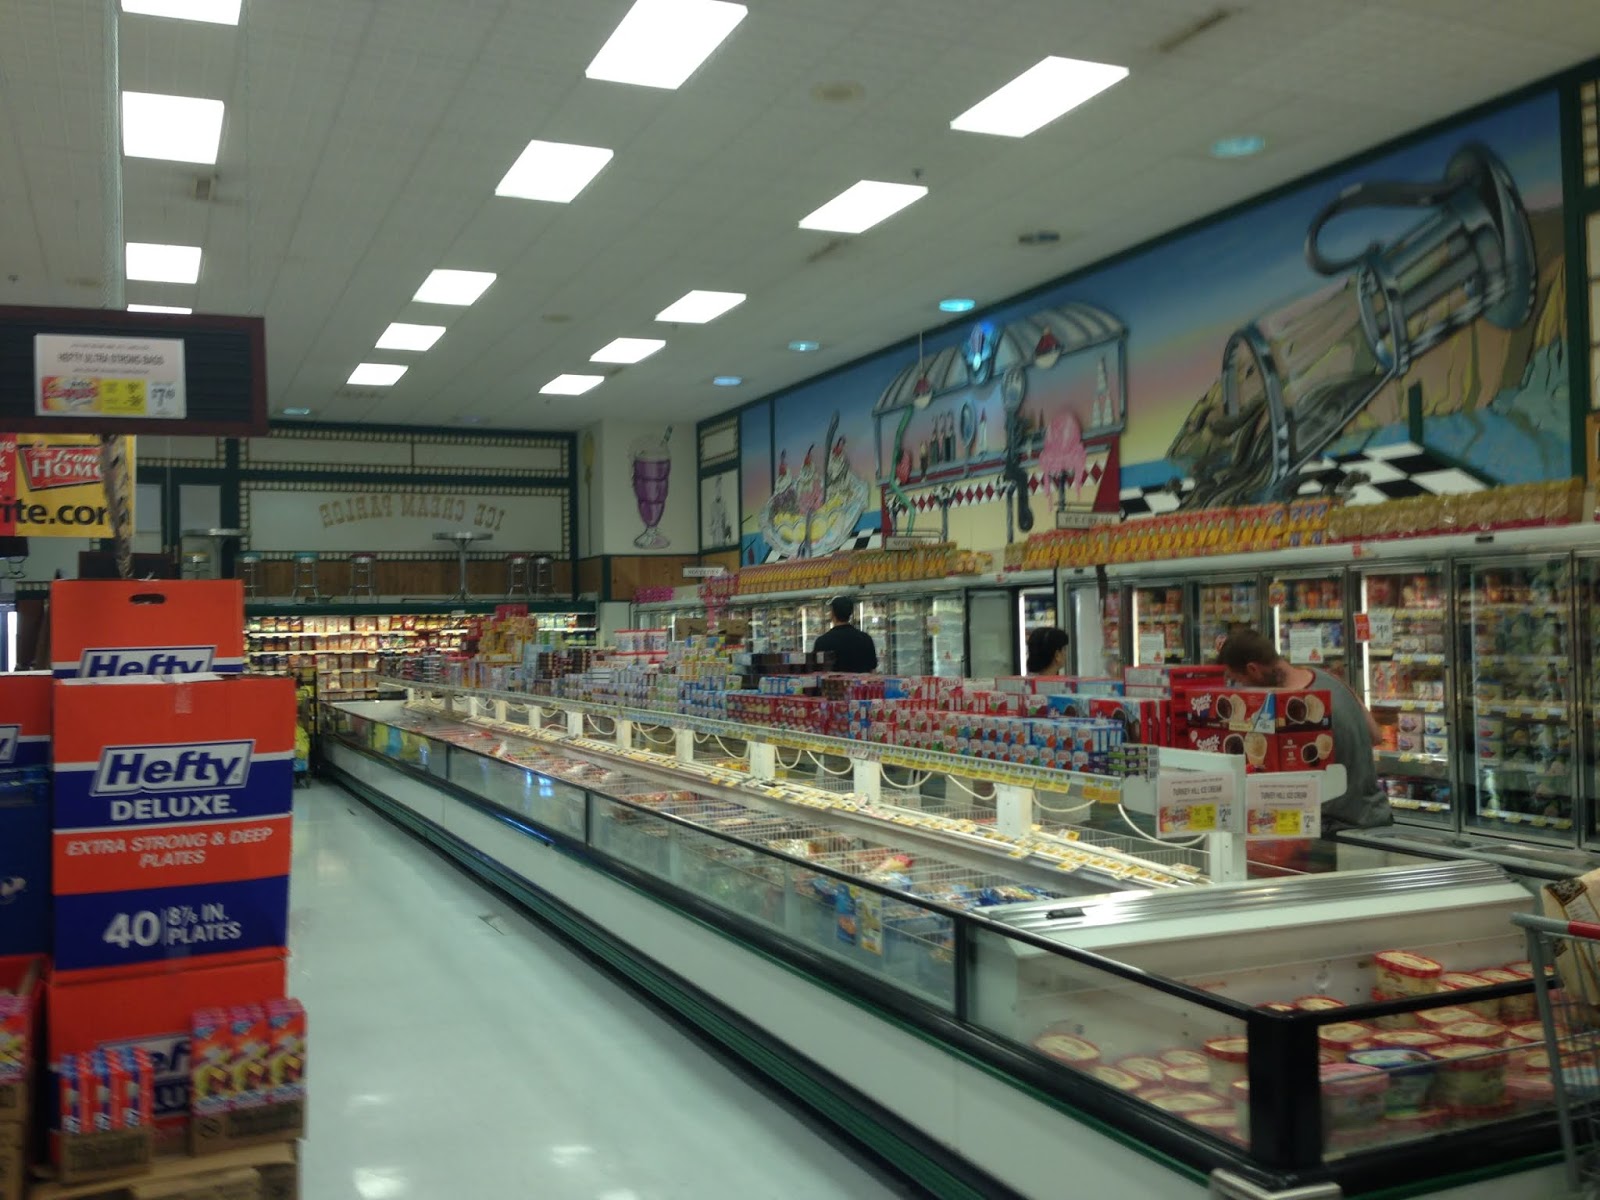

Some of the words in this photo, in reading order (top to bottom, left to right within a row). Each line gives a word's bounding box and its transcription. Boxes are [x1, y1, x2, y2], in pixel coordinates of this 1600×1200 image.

[52, 450, 99, 464] from
[106, 750, 242, 787] Hefty
[111, 794, 231, 821] DELUXE
[65, 839, 126, 856] EXTRA
[131, 832, 207, 852] STRONG
[210, 830, 226, 846] &
[229, 826, 273, 845] DEEP
[138, 848, 206, 869] PLATES
[102, 909, 161, 949] 40
[167, 920, 242, 946] PLATES
